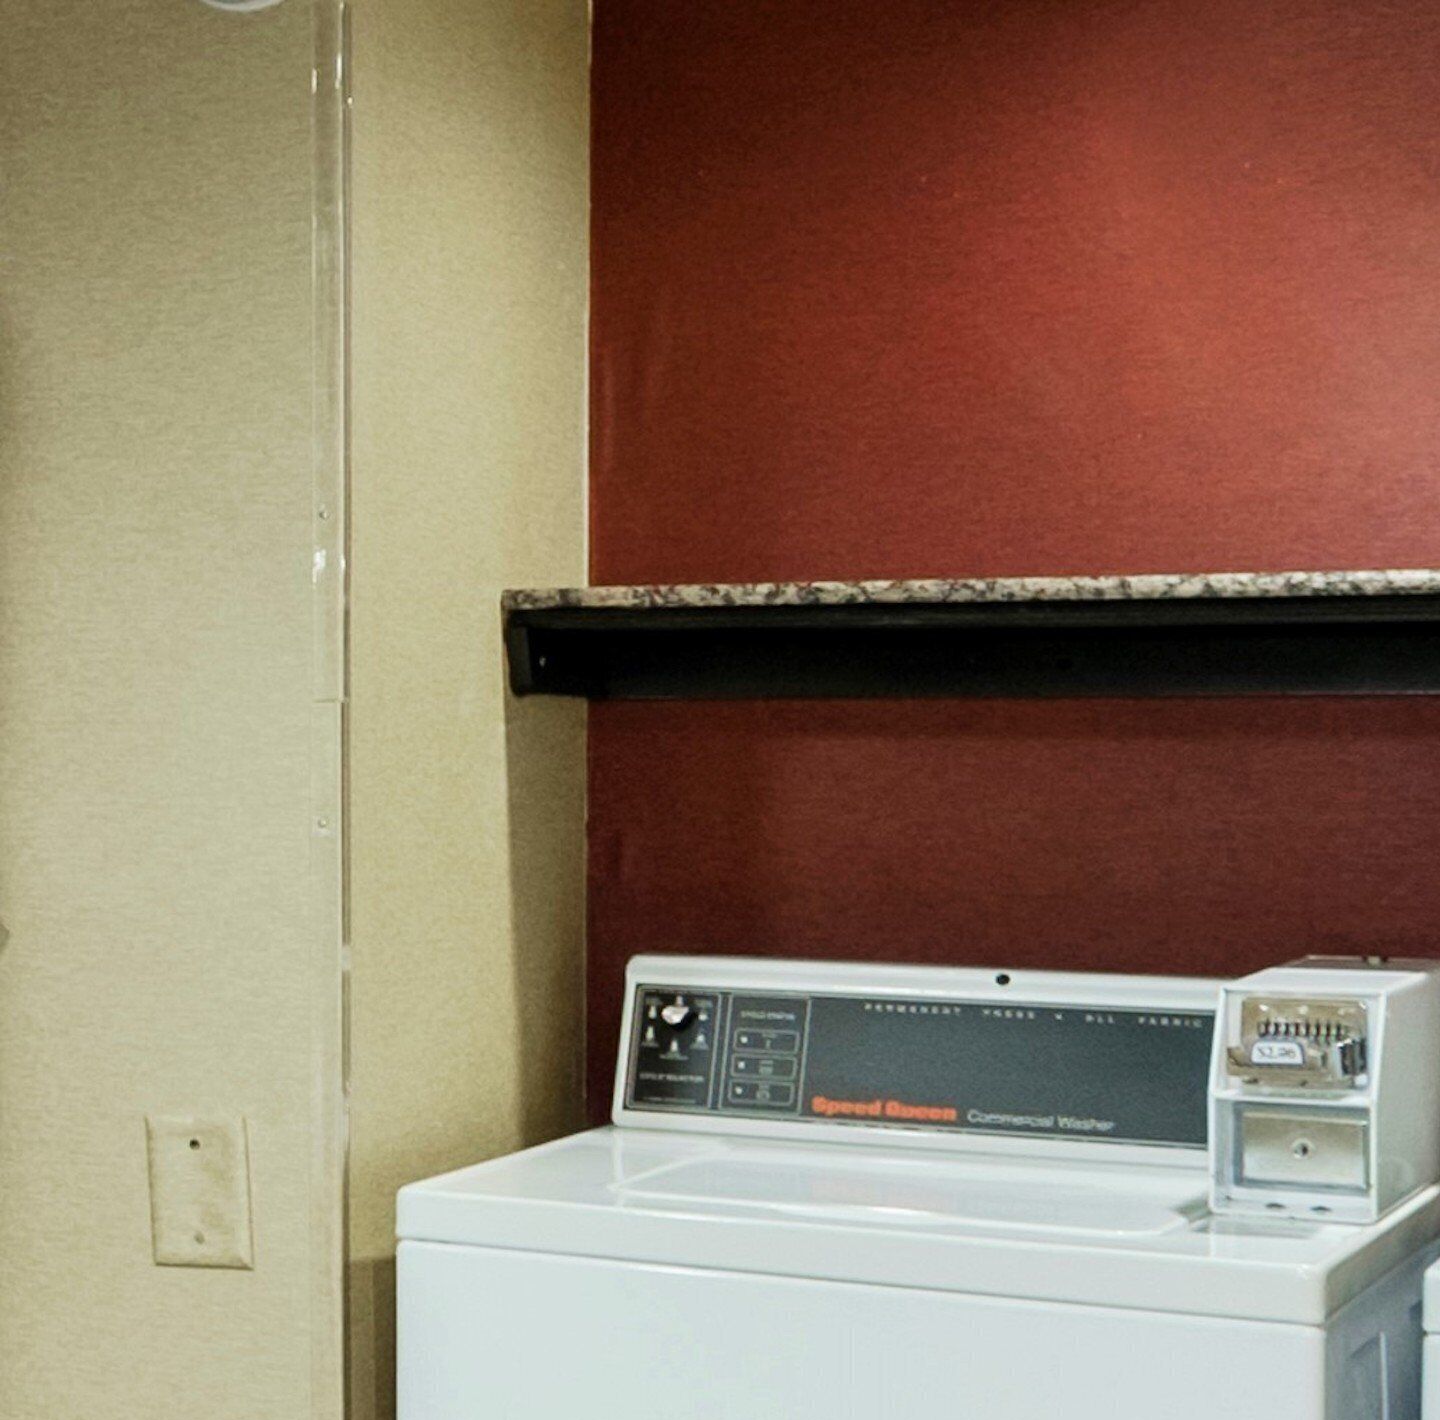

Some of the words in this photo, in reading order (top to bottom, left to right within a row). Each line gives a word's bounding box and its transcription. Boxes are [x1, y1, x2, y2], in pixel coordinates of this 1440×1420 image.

[811, 1095, 882, 1120] Speed
[885, 1100, 958, 1123] Queen
[966, 1108, 1055, 1129] Commercial
[1058, 1115, 1116, 1133] Washer
